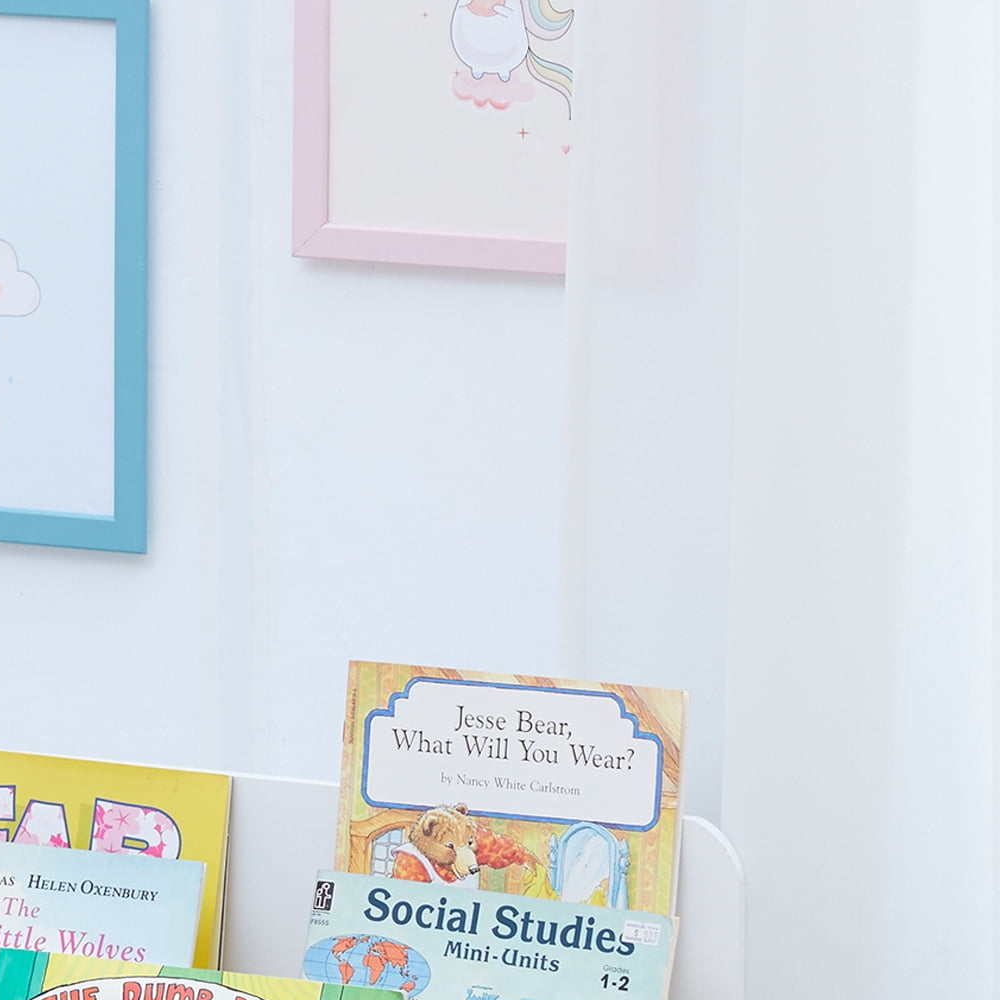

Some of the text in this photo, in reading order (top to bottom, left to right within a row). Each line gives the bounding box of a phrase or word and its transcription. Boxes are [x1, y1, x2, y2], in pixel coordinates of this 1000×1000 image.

[455, 705, 572, 740] Jesse Bear,
[391, 728, 636, 771] What Will You Wear?
[440, 772, 581, 797] by Nancy White Carlstrom
[27, 874, 78, 894] HELEN
[80, 880, 159, 902] OXENBURY
[3, 897, 41, 919] The
[363, 887, 482, 935] Social
[491, 905, 636, 956] Studies
[58, 929, 147, 963] Wolves
[443, 940, 560, 972] Mini-Units
[600, 973, 630, 992] 1-2
[602, 964, 630, 975] Grades
